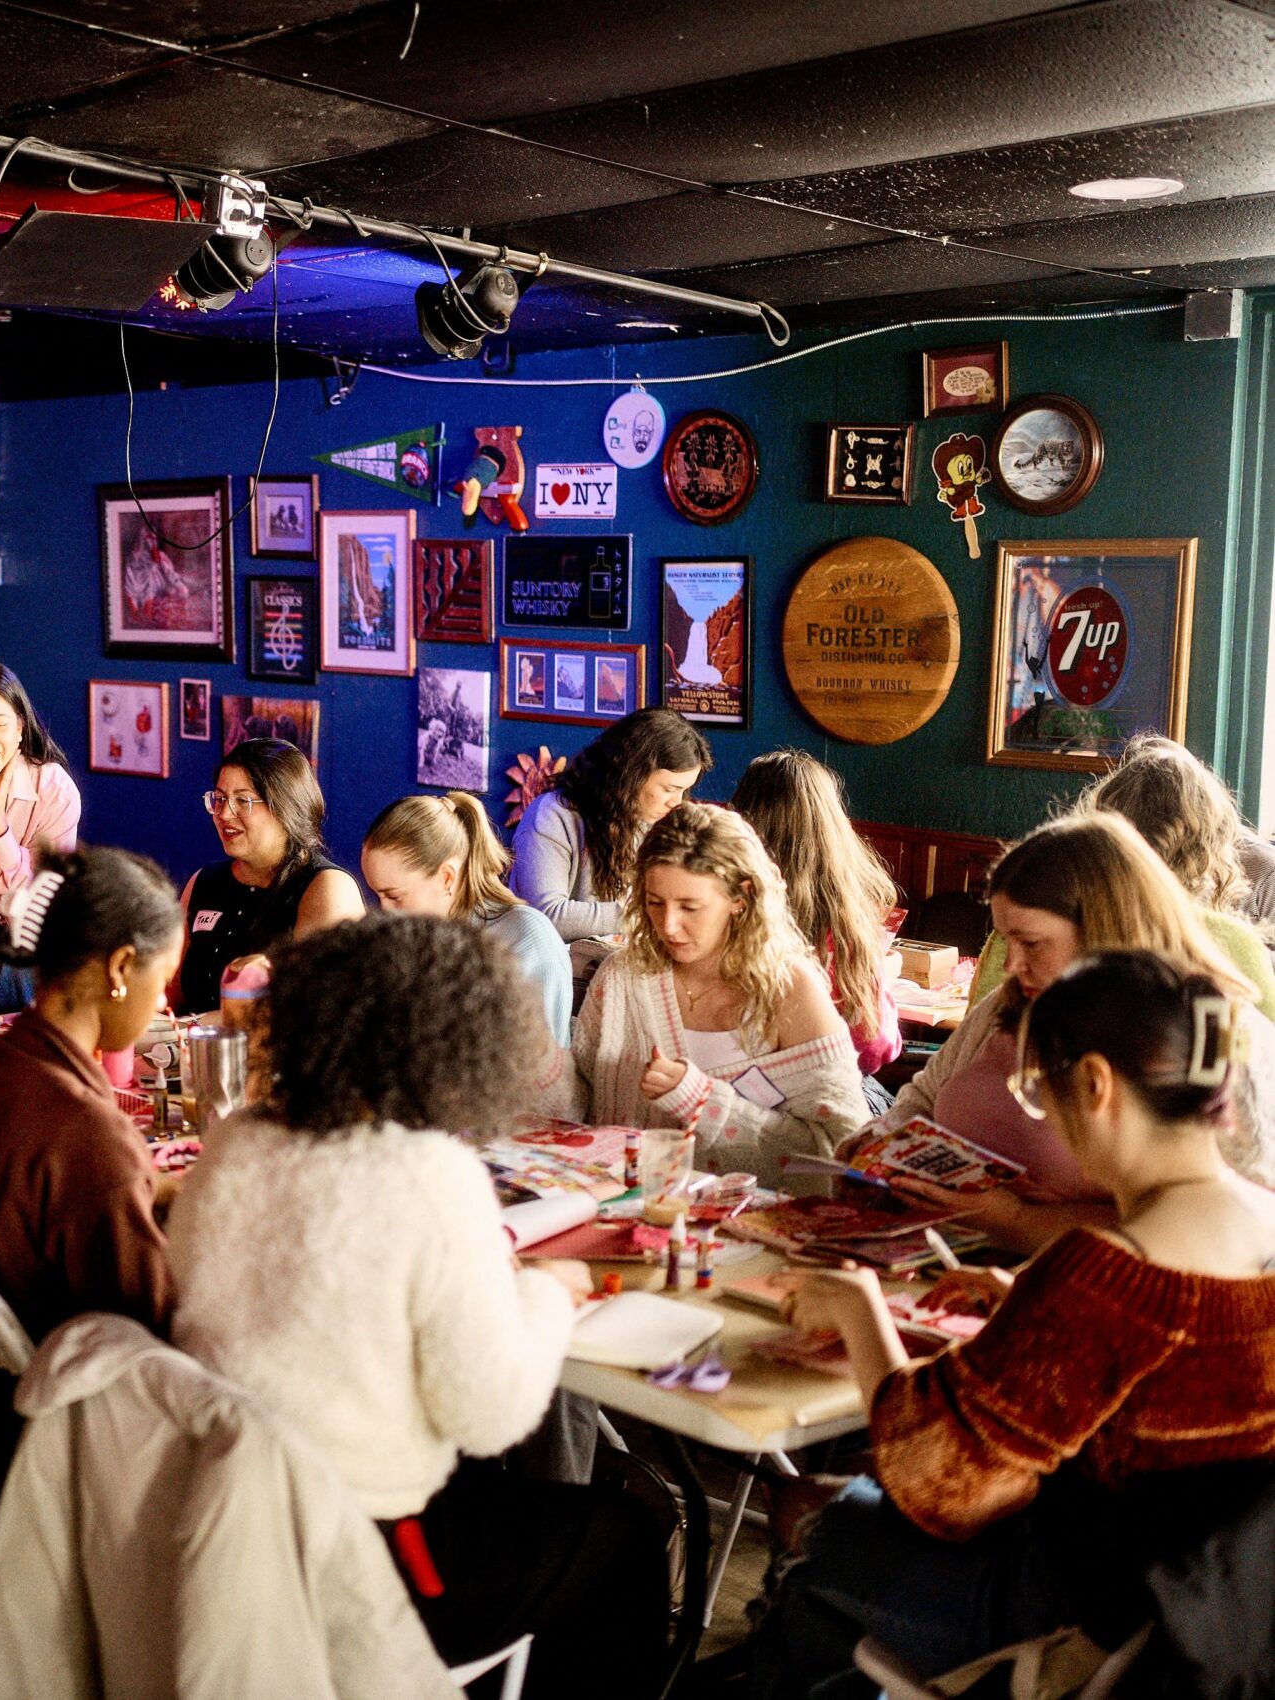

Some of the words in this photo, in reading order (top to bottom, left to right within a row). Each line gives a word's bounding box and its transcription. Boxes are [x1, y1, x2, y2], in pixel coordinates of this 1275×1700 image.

[539, 482, 549, 505] I
[572, 482, 613, 505] NY
[512, 581, 582, 598] SUNTORY
[264, 594, 304, 608] CLASSICS
[512, 599, 572, 616] WHISKY
[1064, 602, 1087, 611] fresh
[844, 604, 885, 625] OLD
[806, 623, 921, 648] FORESTER
[821, 652, 885, 664] DISTILLING
[816, 676, 863, 688] BOURBON
[869, 678, 912, 691] WHISKY
[681, 690, 730, 700] YELLOWSTONE
